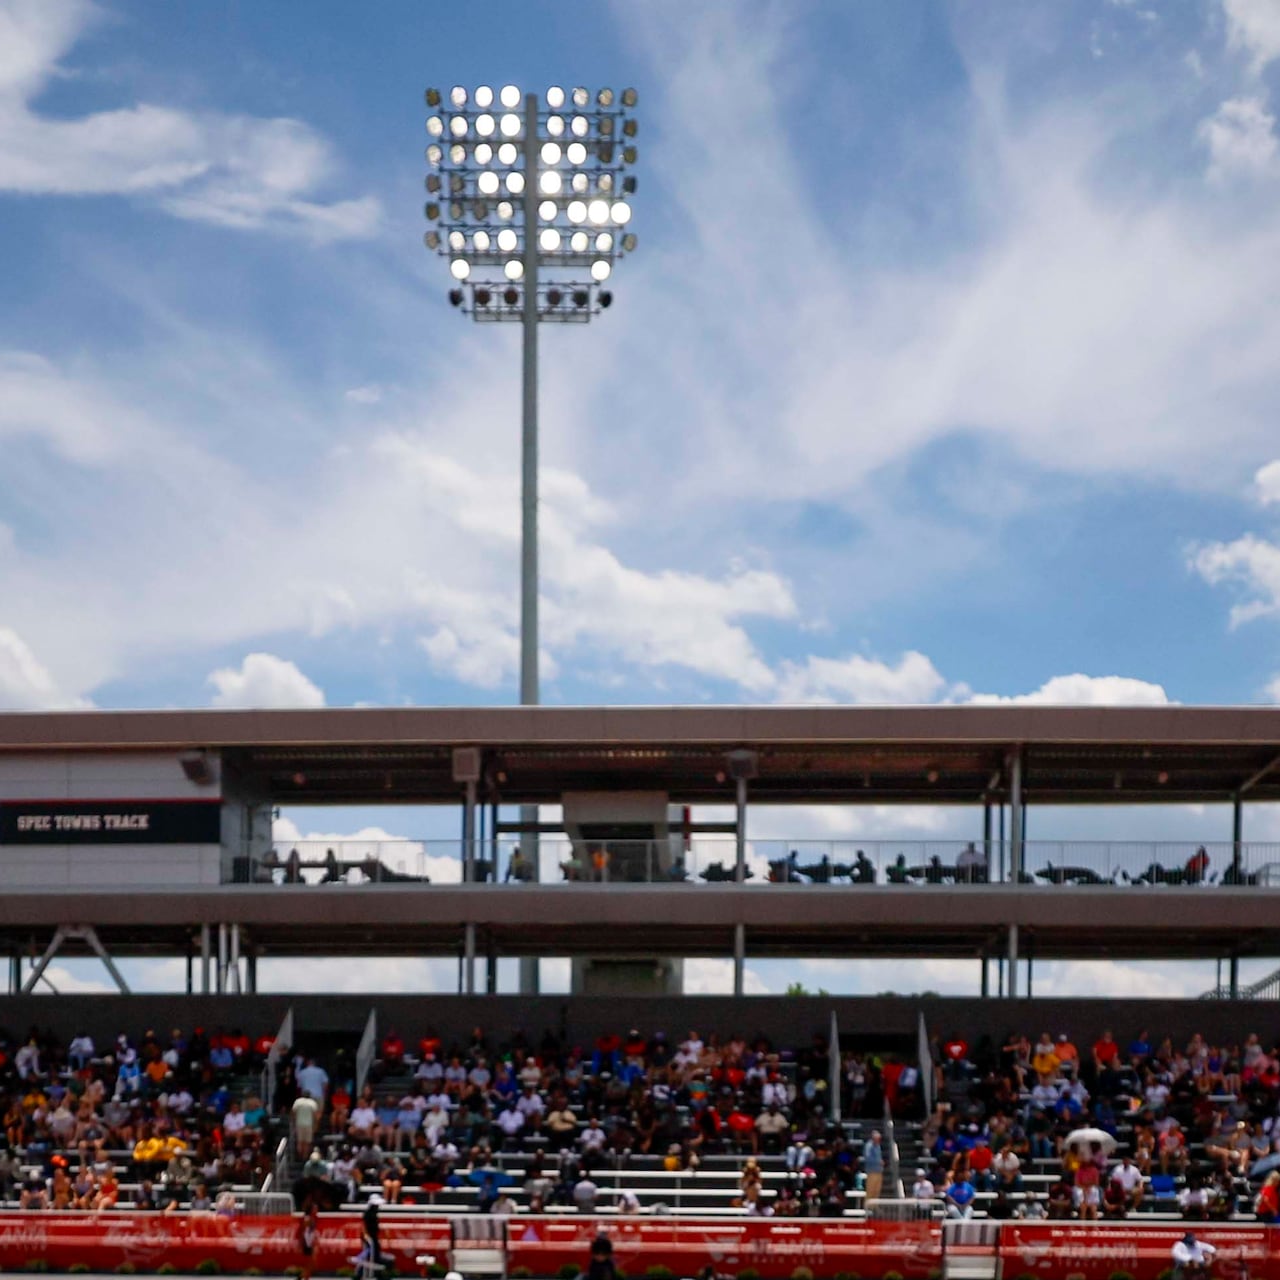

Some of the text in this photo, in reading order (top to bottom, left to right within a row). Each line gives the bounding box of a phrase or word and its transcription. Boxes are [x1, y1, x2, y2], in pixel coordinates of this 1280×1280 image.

[17, 814, 149, 831] SPEC TOWNS TRACK
